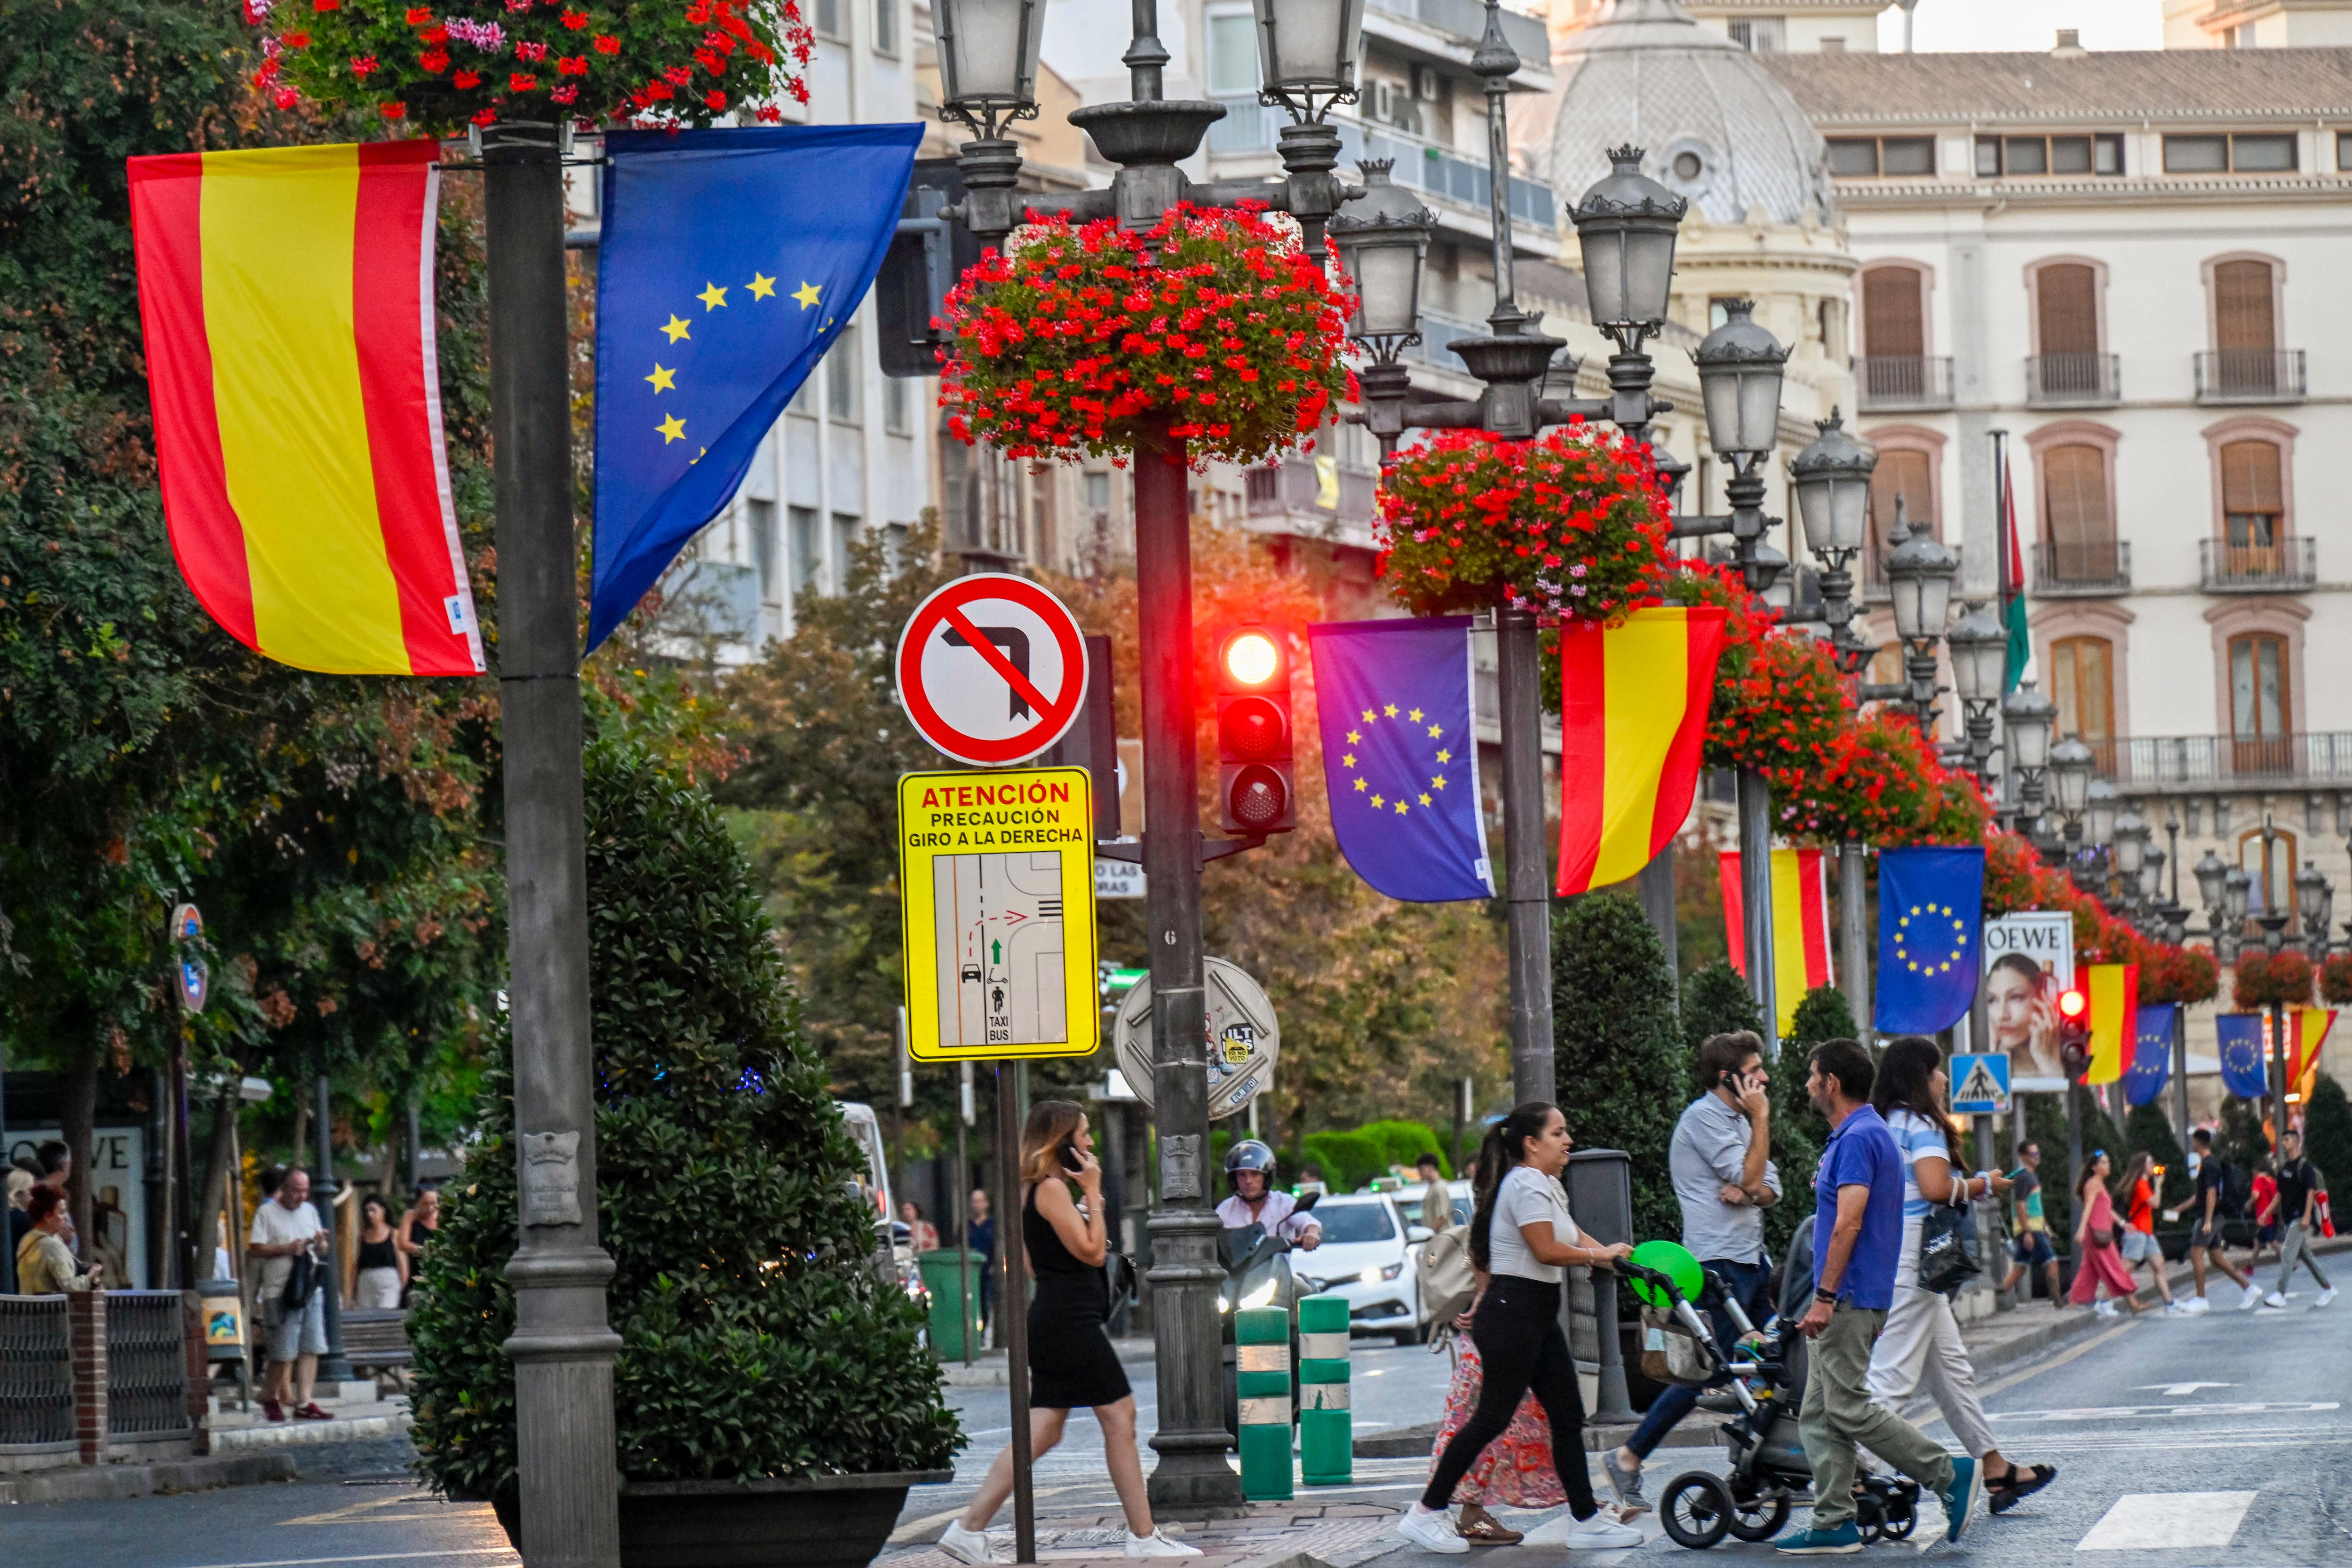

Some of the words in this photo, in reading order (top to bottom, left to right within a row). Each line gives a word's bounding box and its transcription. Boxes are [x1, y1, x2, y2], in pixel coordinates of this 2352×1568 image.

[922, 779, 1069, 808] ATENCIÓN
[931, 808, 1059, 827] PRECAUCIÓN
[909, 832, 951, 847] GIRO
[958, 832, 969, 845] A
[975, 831, 995, 845] LA
[1001, 828, 1083, 844] DERECHA
[1987, 926, 2060, 950] OEWE
[989, 1016, 1009, 1027] TAXI
[990, 1029, 1009, 1040] BUS
